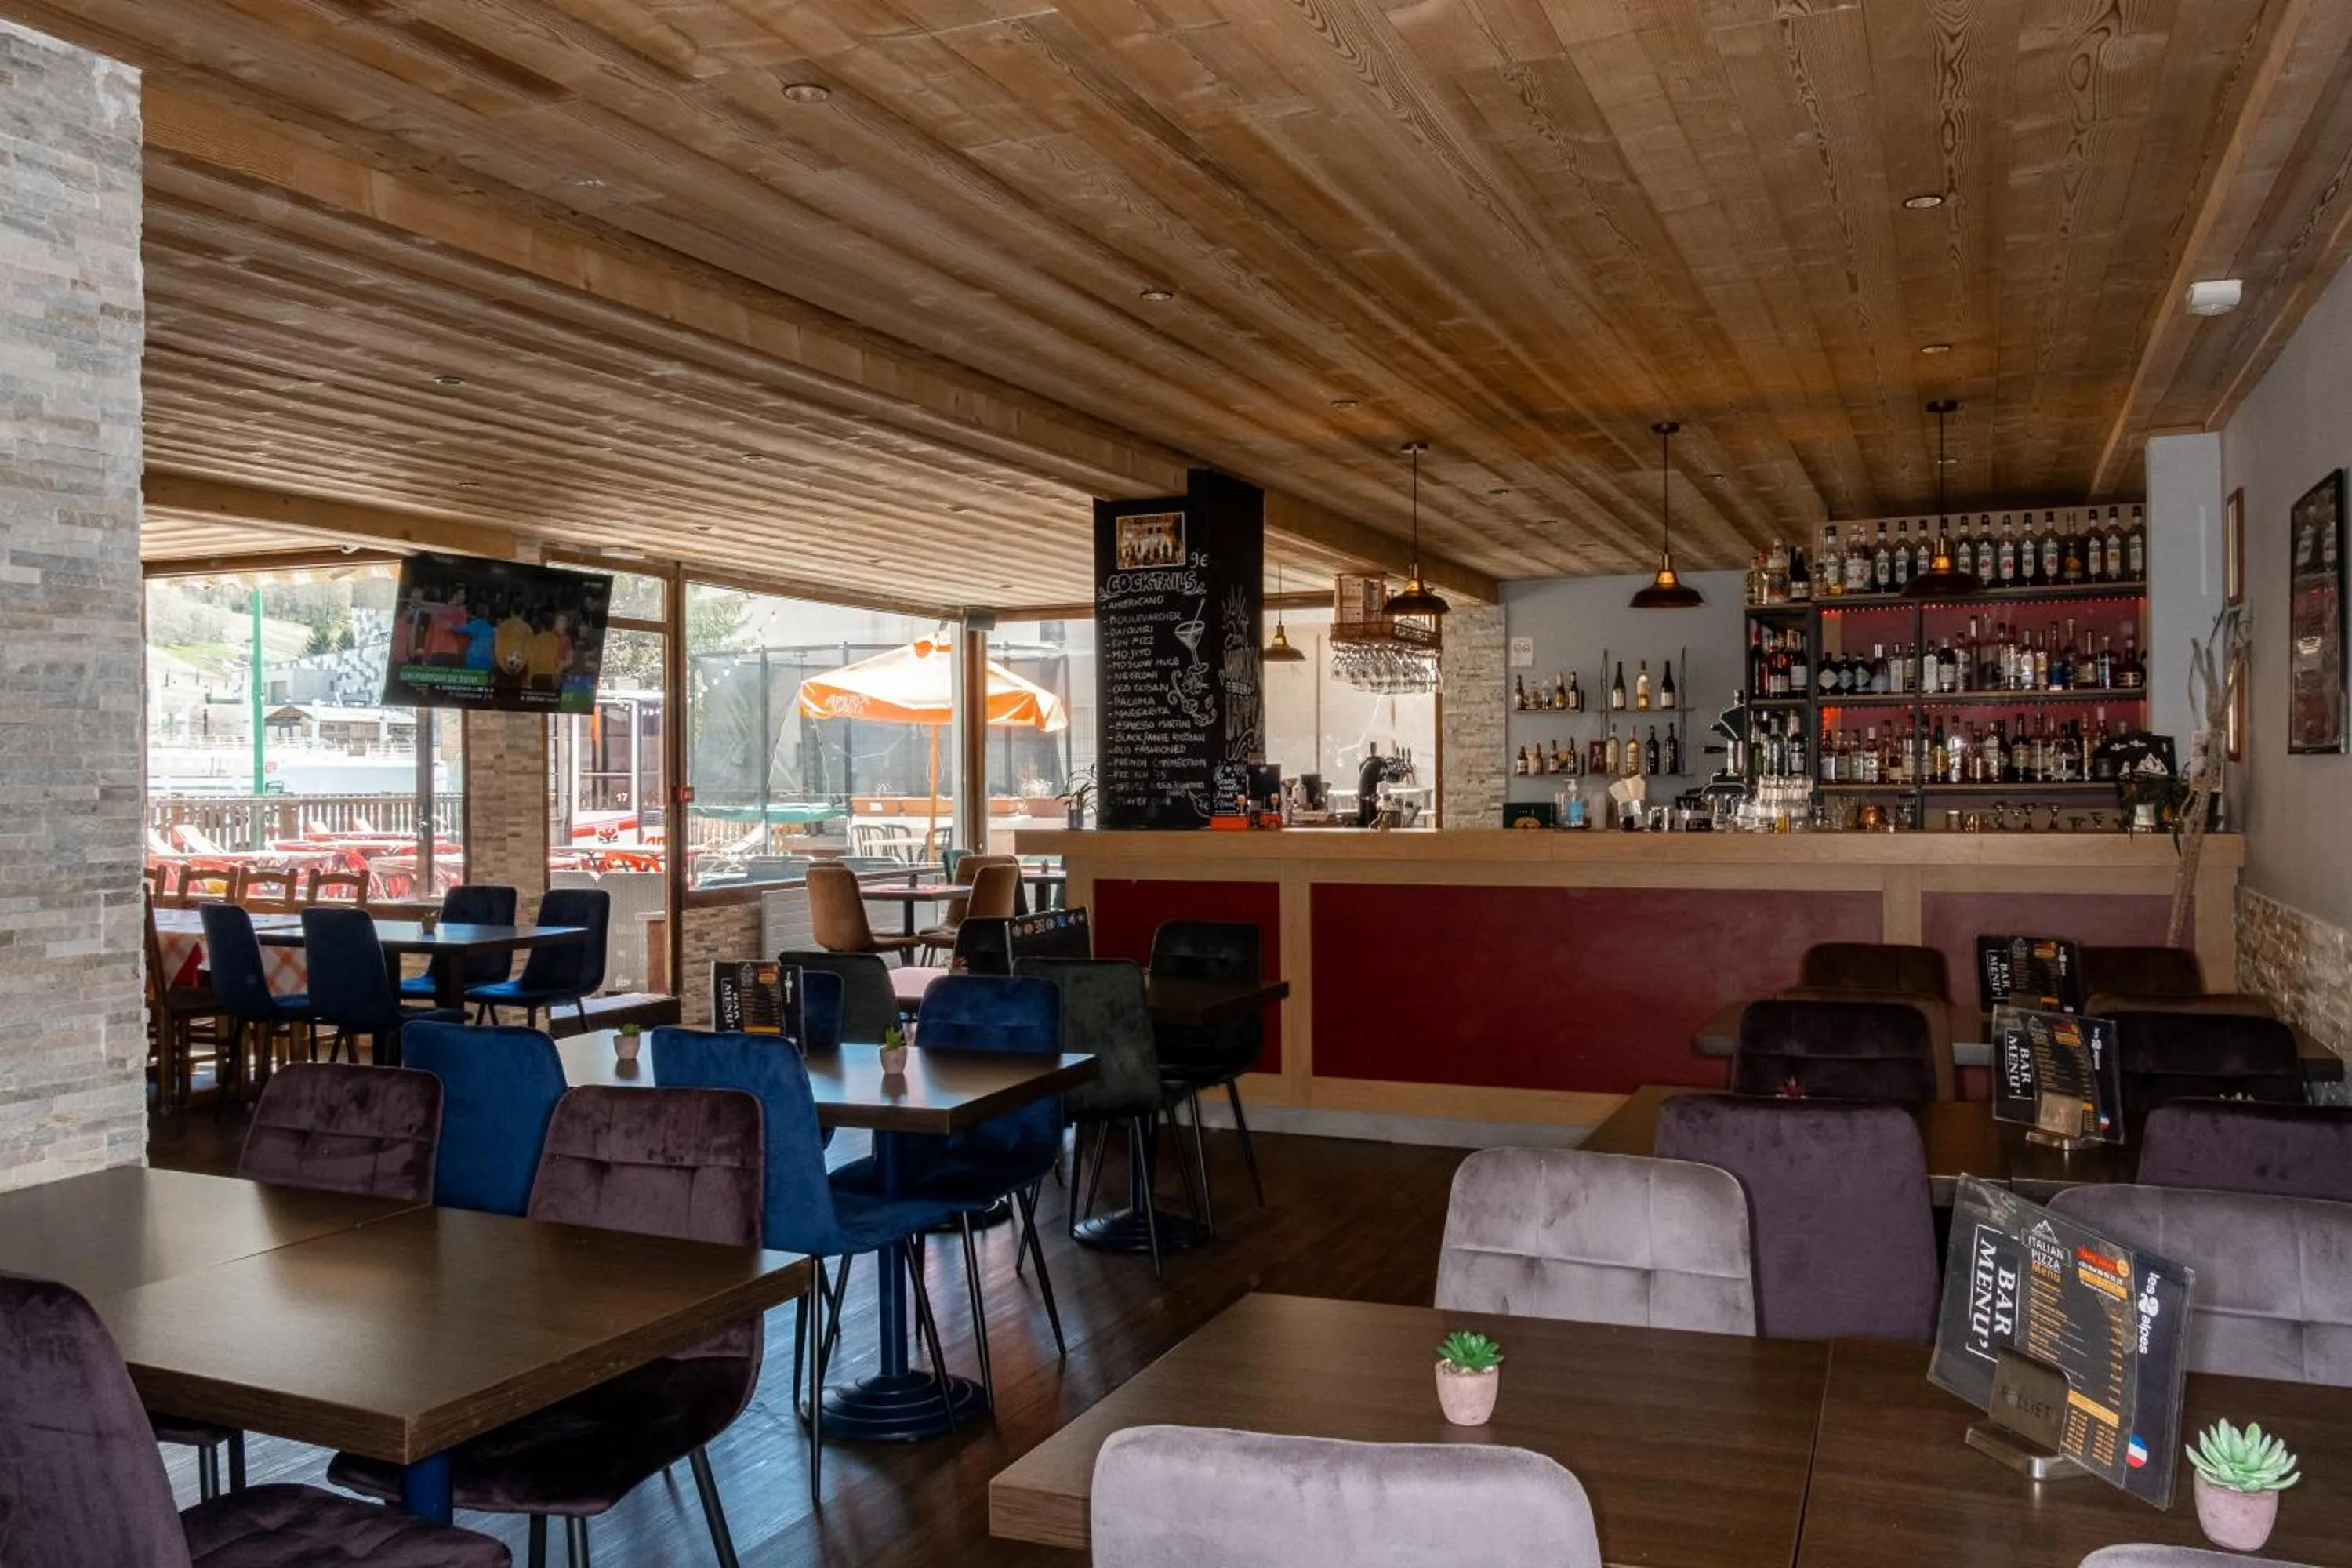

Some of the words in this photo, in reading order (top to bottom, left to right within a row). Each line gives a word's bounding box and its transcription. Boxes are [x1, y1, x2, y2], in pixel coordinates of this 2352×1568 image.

[1191, 552, 1207, 568] 9€
[1106, 571, 1198, 595] COCKTAILS
[1109, 597, 1164, 609] AMERICANO
[1110, 612, 1182, 625] BOULEVARDIER
[1111, 637, 1129, 648] GIN
[1132, 636, 1155, 646] FIZZ
[1112, 648, 1152, 659] MOJITO
[1112, 659, 1153, 670] MOSCOW
[1155, 657, 1180, 667] MULE
[1113, 670, 1159, 681] NEGRONI
[1112, 684, 1132, 695] OLD
[1133, 683, 1170, 694] CUBAN
[1114, 695, 1156, 707] PALOMA
[1114, 706, 1171, 718] MARGARITA
[1116, 720, 1155, 731] ESPRESSO
[1158, 719, 1192, 729] MARTINI
[1172, 731, 1206, 742] RUSSIAN
[1114, 745, 1131, 755] OLD
[1134, 744, 1187, 755] FASHIONED
[616, 793, 628, 802] 17
[1999, 963, 2011, 988] BAR
[2019, 1047, 2031, 1083] BAR
[2028, 1235, 2064, 1260] ITALIAN
[2031, 1247, 2061, 1274] PIZZA
[2031, 1260, 2061, 1283] Menu
[2146, 1272, 2161, 1294] les
[1994, 1266, 2016, 1335] BAR
[2138, 1315, 2152, 1354] alpes
